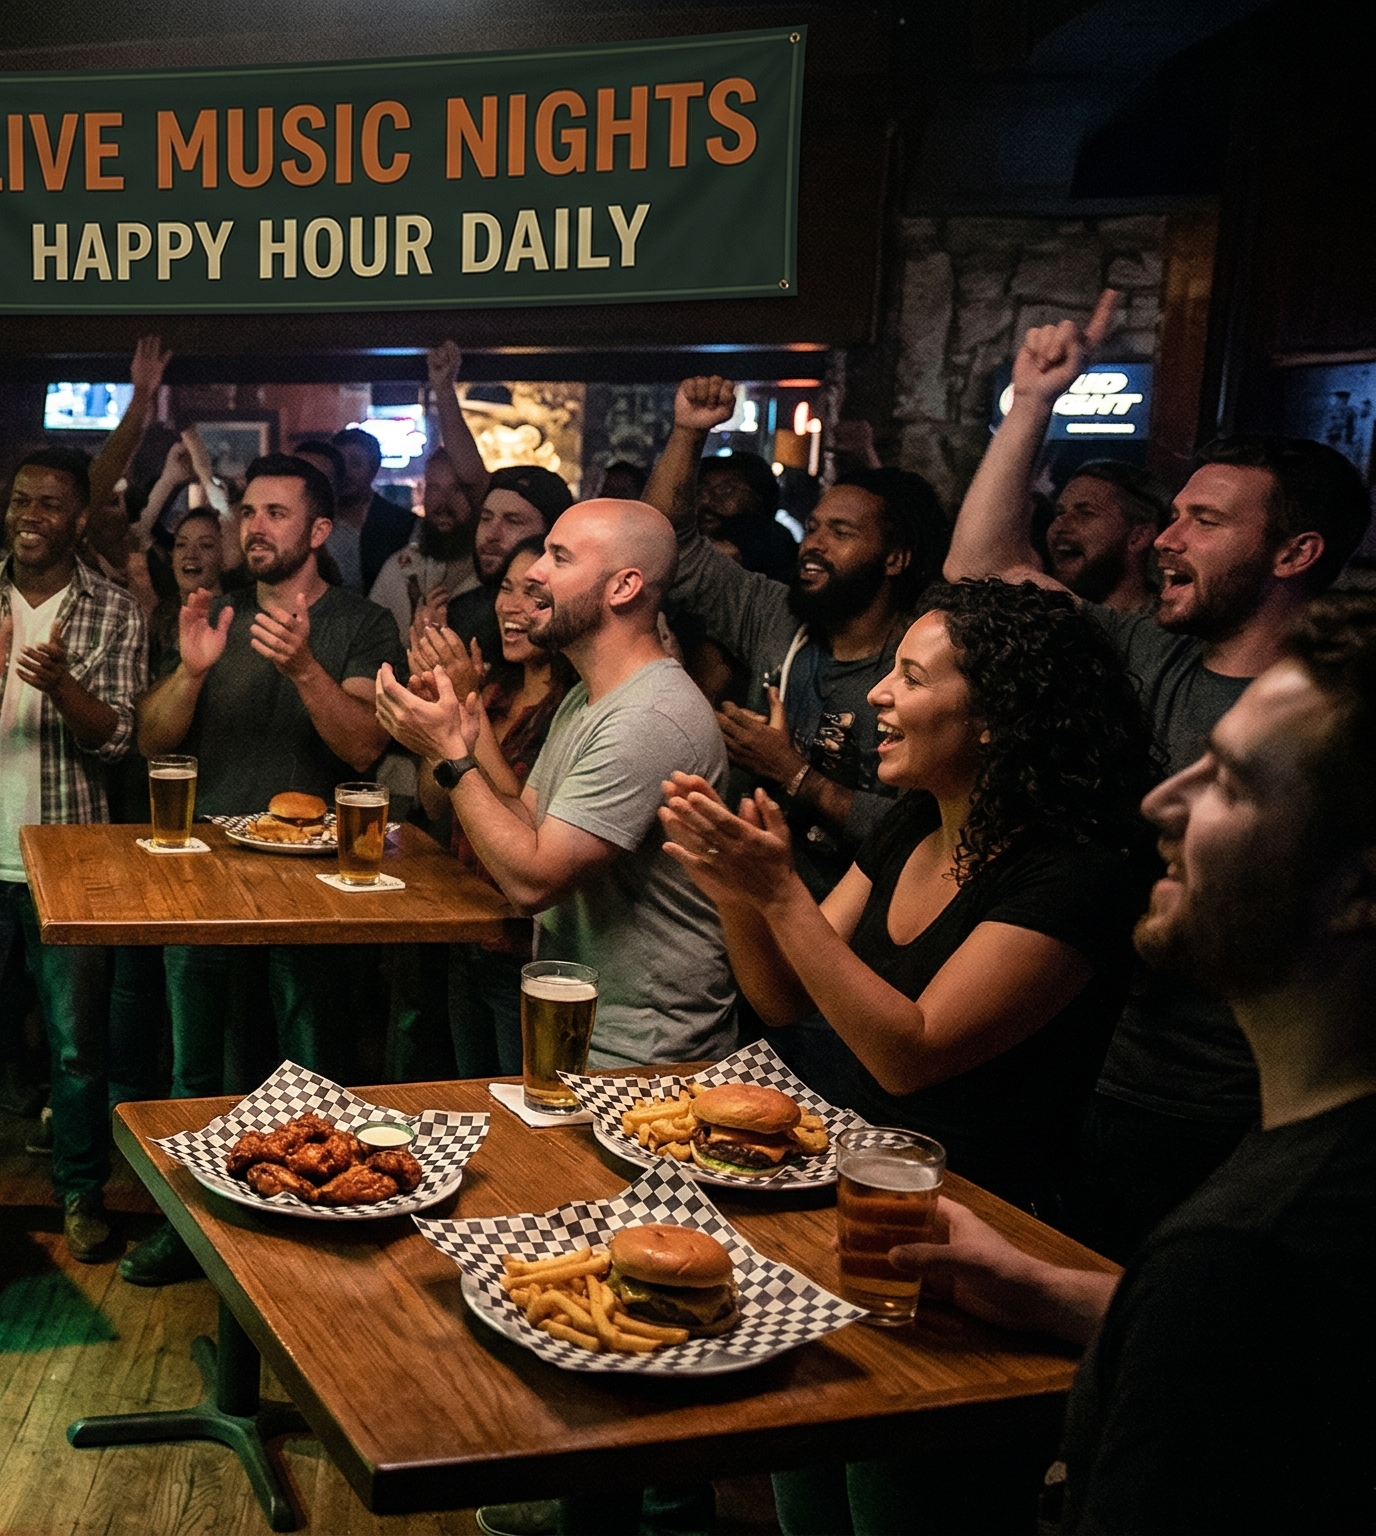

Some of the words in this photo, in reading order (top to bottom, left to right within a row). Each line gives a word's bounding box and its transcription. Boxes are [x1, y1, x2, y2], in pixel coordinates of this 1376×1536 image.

[156, 100, 412, 190] MUSIC
[445, 77, 758, 180] NIGHTS
[31, 221, 235, 282] HAPPY
[258, 214, 434, 279] HOUR
[460, 203, 651, 274] DAILY
[1068, 372, 1129, 394] UD
